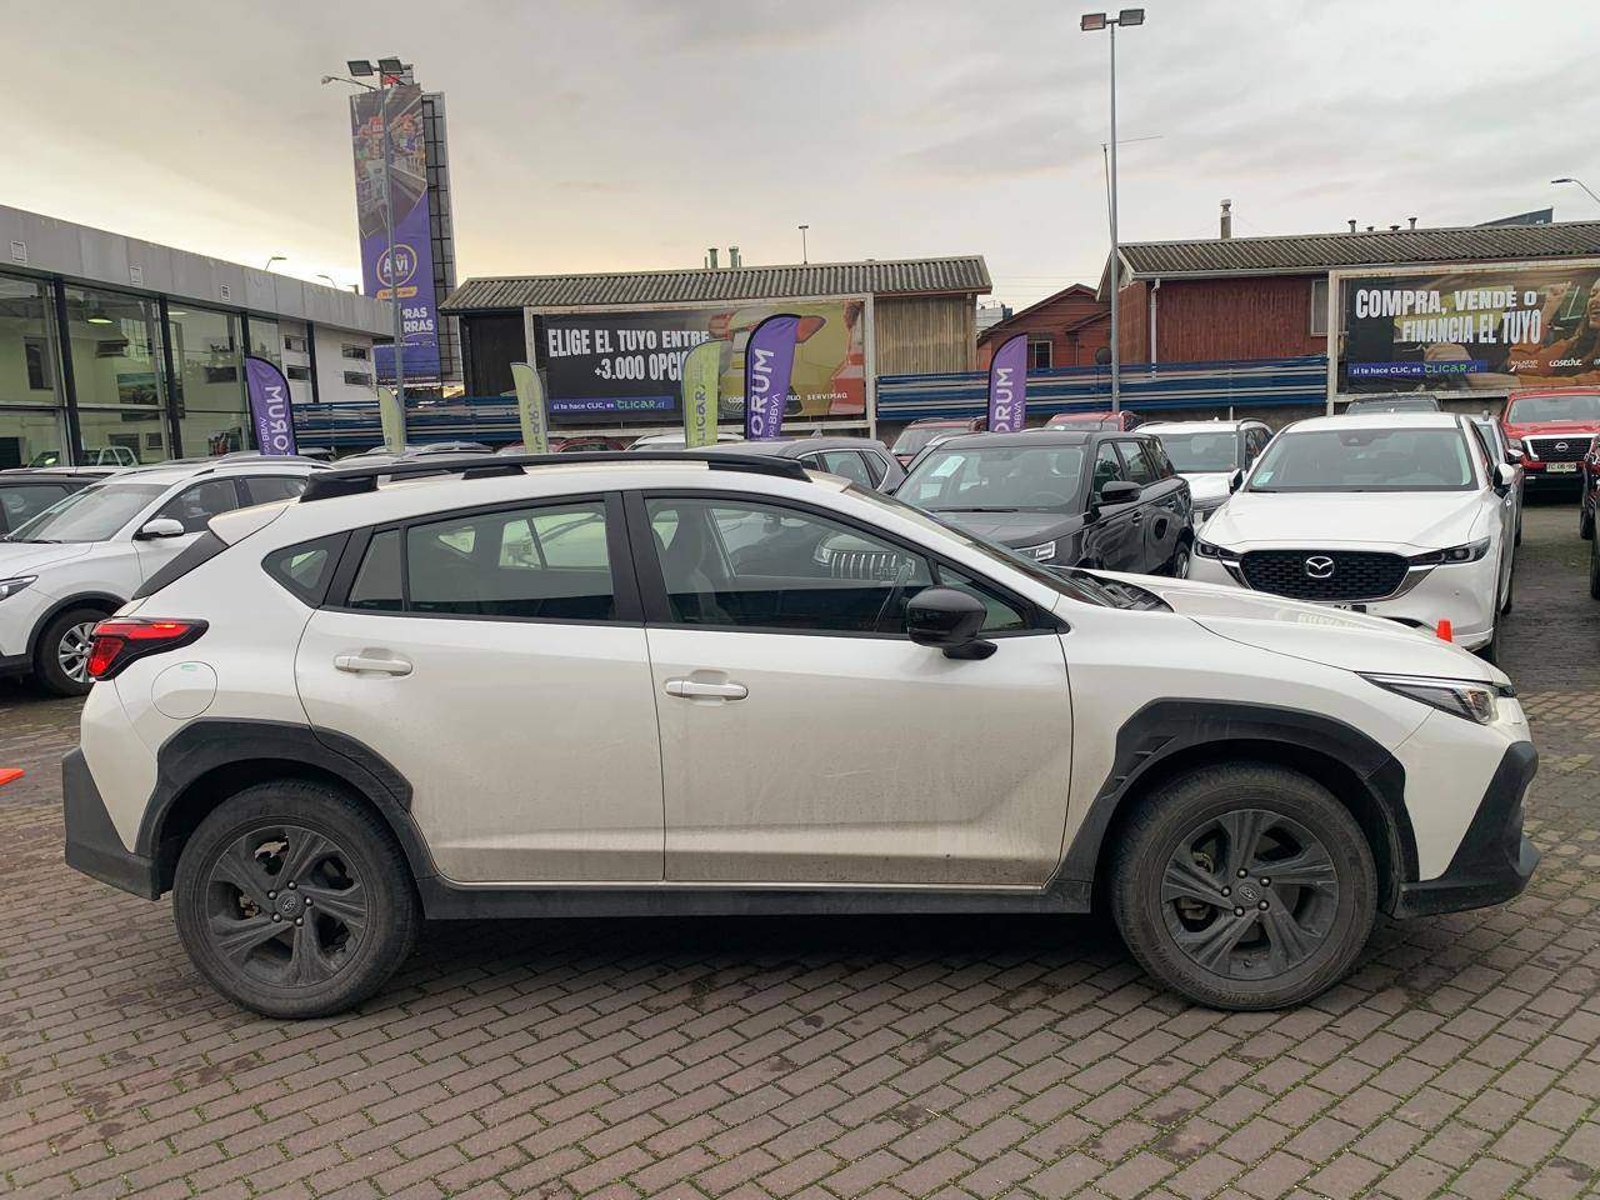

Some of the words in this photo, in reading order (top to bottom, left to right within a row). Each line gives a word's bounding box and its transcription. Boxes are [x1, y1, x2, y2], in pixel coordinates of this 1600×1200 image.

[1355, 288, 1447, 319] COMPRA,
[1454, 290, 1517, 312] VENDE
[1402, 315, 1474, 344] FINANCIA
[1478, 313, 1497, 344] EL
[1501, 309, 1542, 344] TUYO
[547, 328, 591, 358] ELIGE
[594, 329, 614, 354] EL
[617, 329, 657, 352] TUYO
[661, 330, 710, 349] ENTRE
[594, 354, 646, 380] +3.000
[569, 402, 585, 410] hace
[751, 348, 775, 436] ORUM
[994, 367, 1013, 432] ORUM
